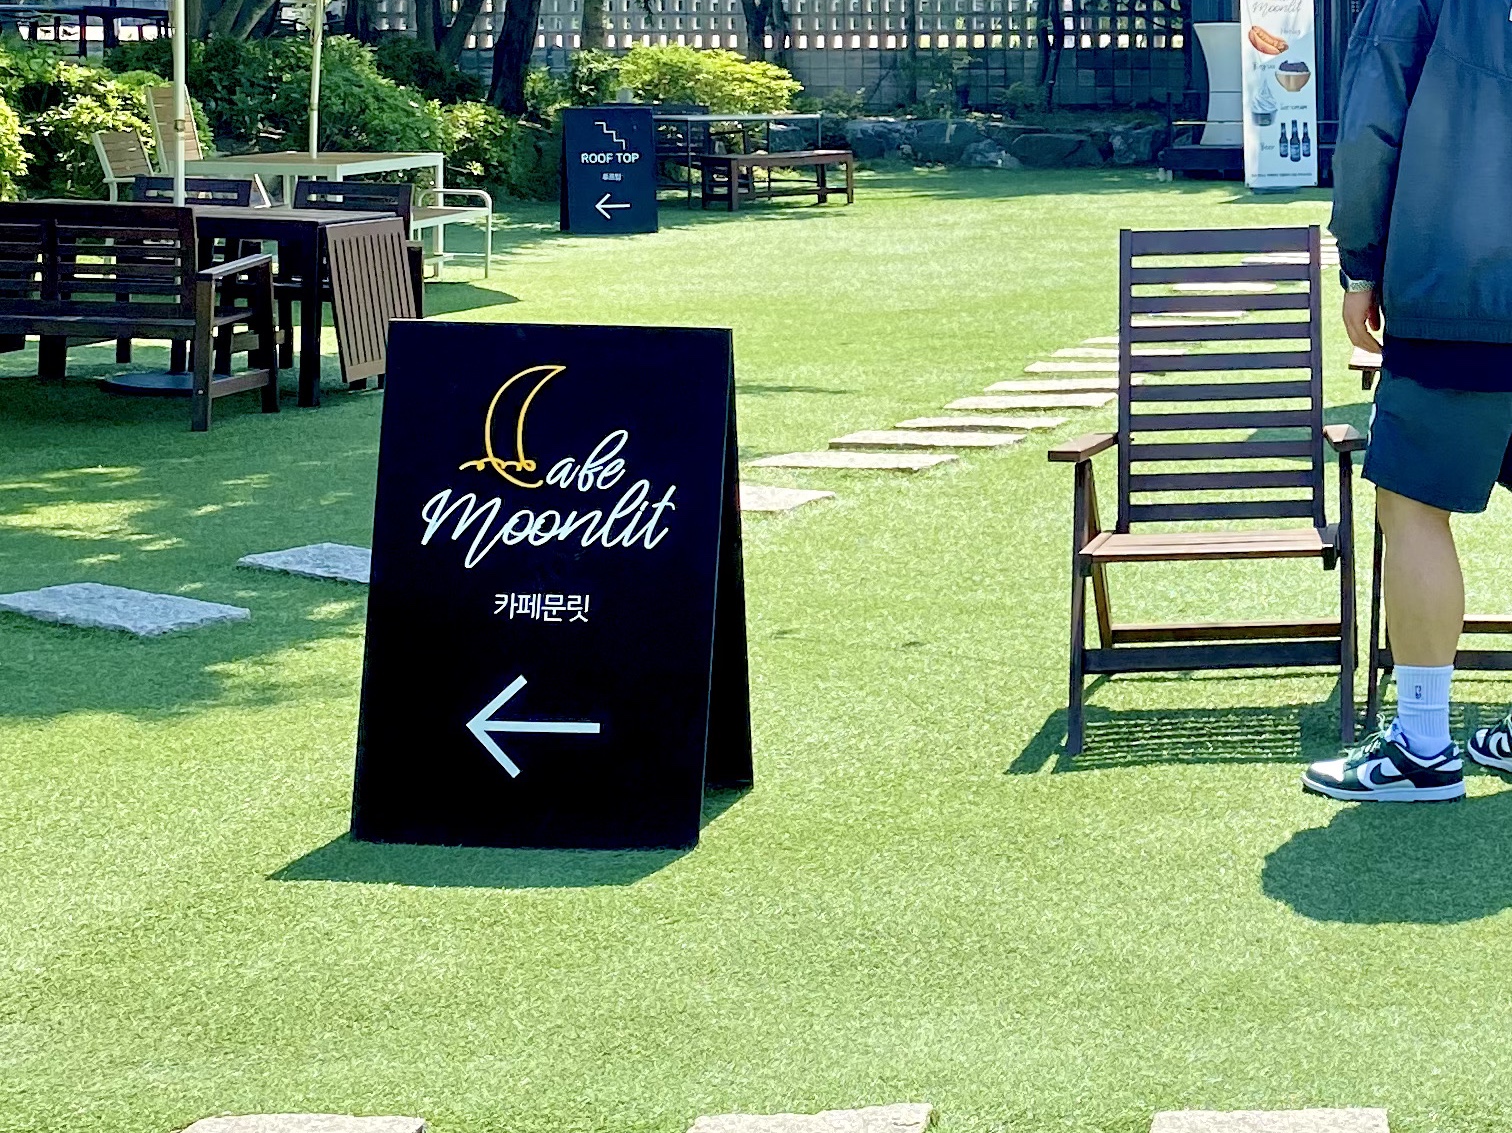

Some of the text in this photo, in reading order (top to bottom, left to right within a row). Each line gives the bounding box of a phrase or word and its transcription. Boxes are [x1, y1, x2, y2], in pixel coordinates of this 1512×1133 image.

[581, 153, 640, 163] ROOF TOP
[421, 479, 677, 569] Moonlit
[494, 592, 590, 623] 카페문릿
